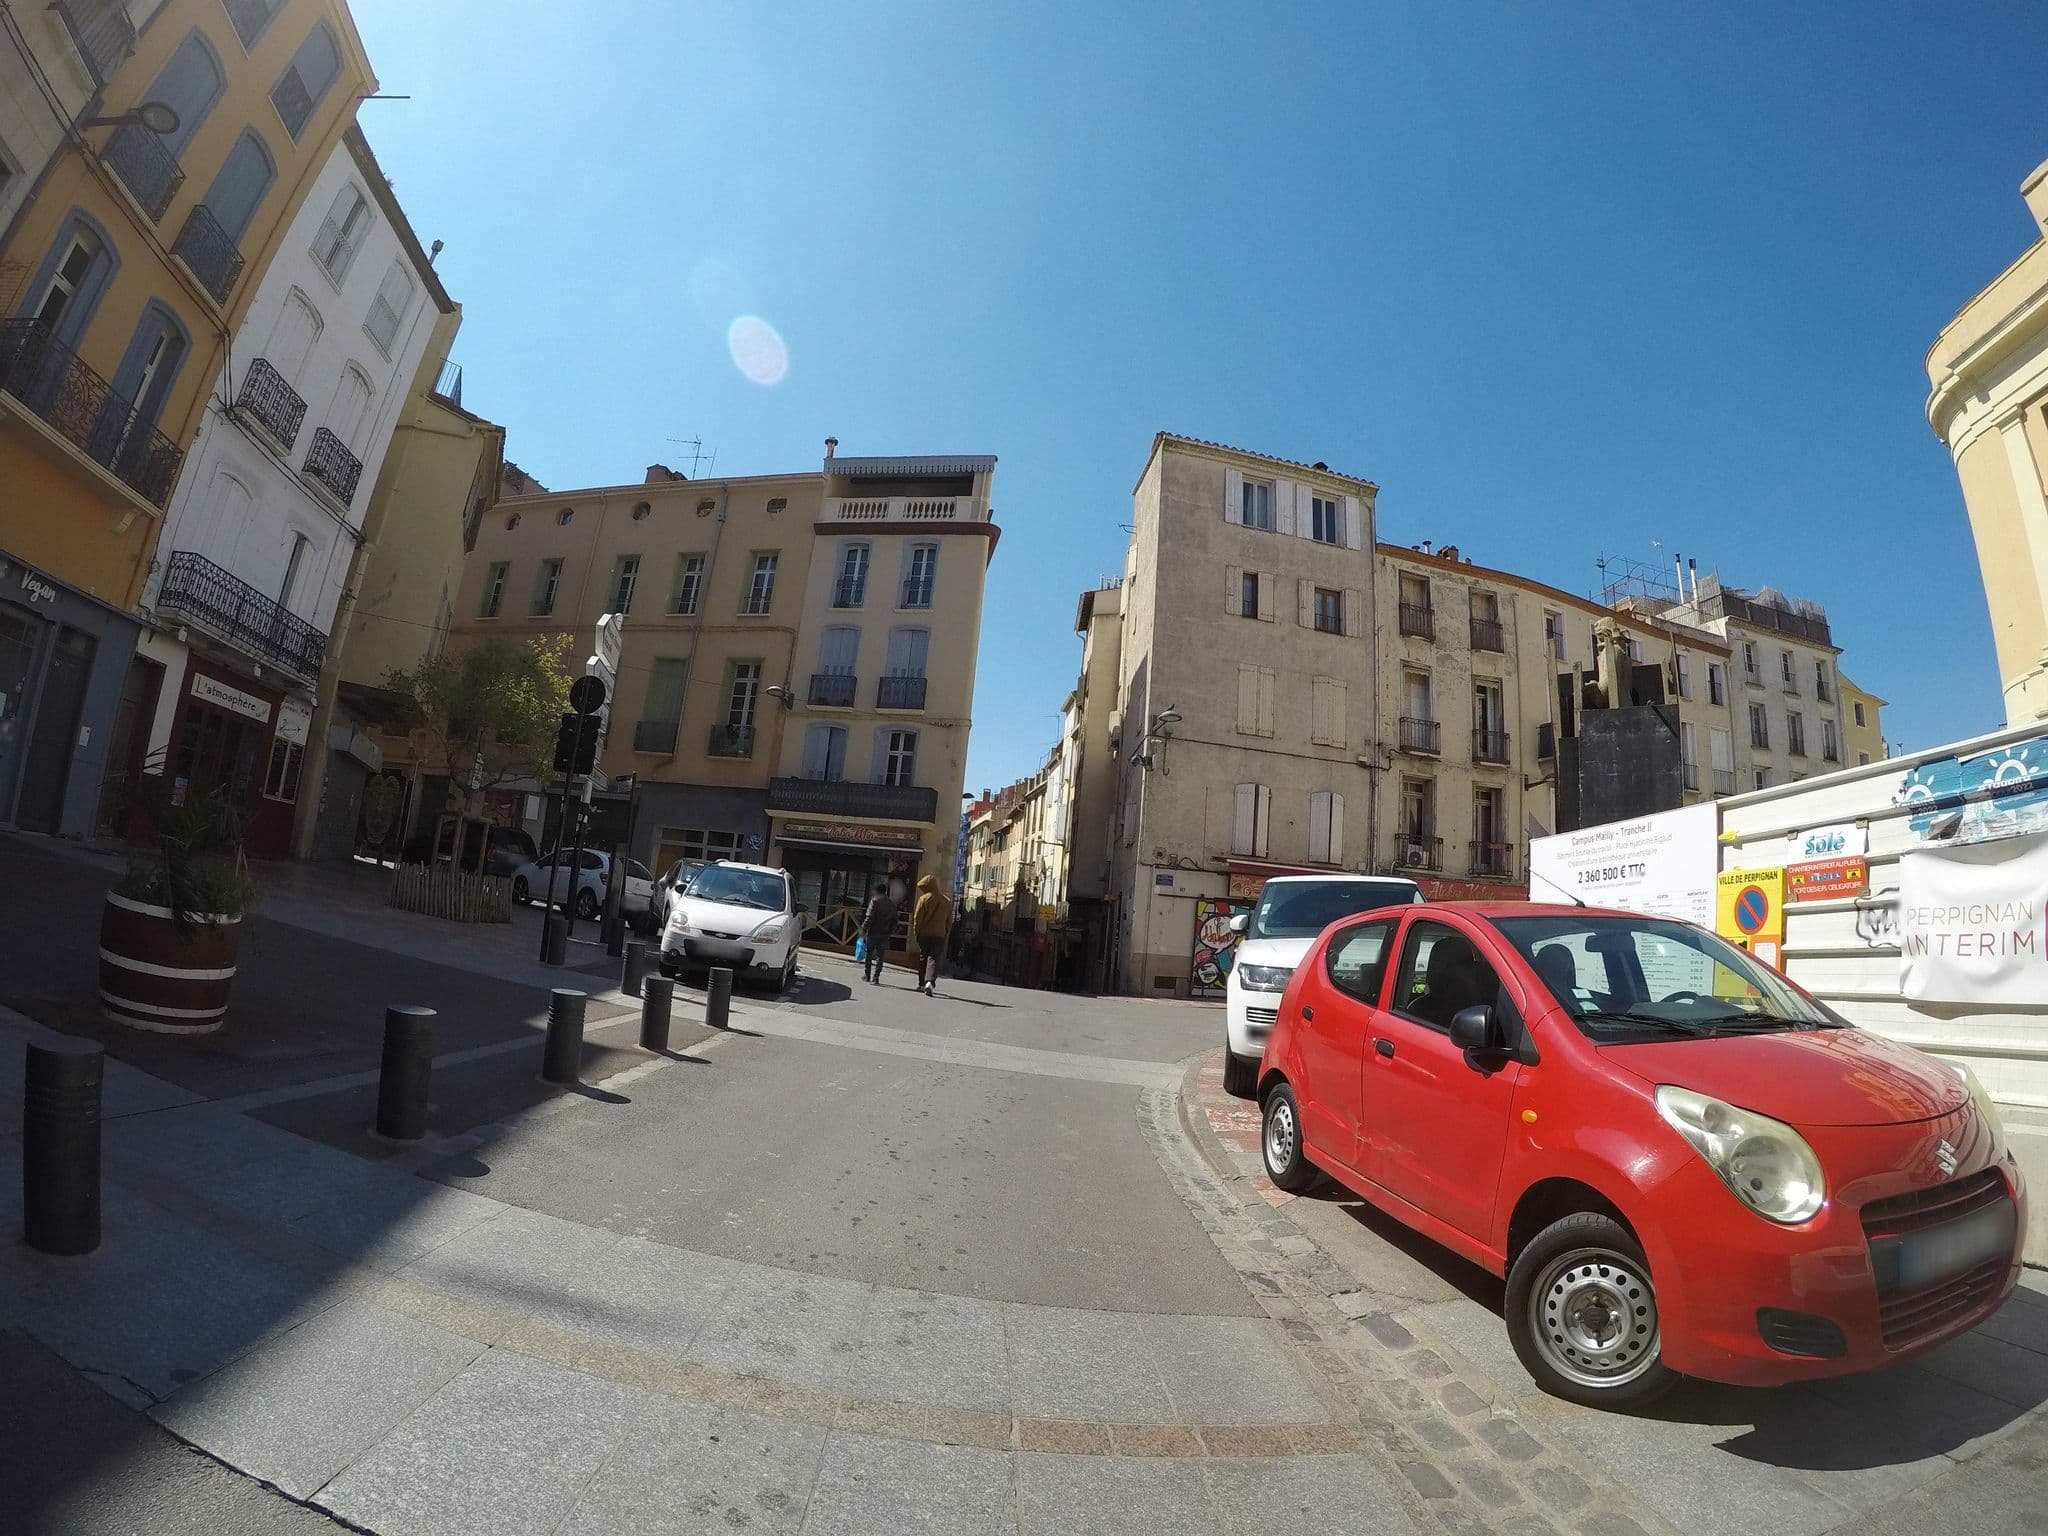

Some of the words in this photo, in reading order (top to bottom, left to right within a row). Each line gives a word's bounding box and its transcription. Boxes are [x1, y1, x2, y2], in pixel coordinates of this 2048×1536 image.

[21, 570, 56, 602] Vegan
[195, 676, 257, 712] L'atmosphère
[2012, 782, 2034, 794] 2022
[1571, 836, 1595, 847] Campus
[1595, 830, 1614, 842] Mailly
[1620, 824, 1646, 837] Tranche
[1647, 821, 1652, 832] II
[1654, 832, 1672, 845] Rigaud
[1804, 830, 1846, 856] Solé
[1578, 871, 1583, 884] 2
[1585, 868, 1600, 883] 360
[1602, 866, 1618, 881] 500
[1620, 864, 1626, 879] €
[1628, 862, 1646, 878] TTC
[1719, 874, 1734, 886] VILLE
[1735, 873, 1743, 884] DE
[1744, 870, 1778, 882] PERPIGNAN
[1788, 863, 1812, 874] CHANTIER
[1812, 861, 1835, 871] INTERDIT
[1906, 900, 2033, 927] PERPIGNAN
[1906, 929, 2035, 957] INTERIM
